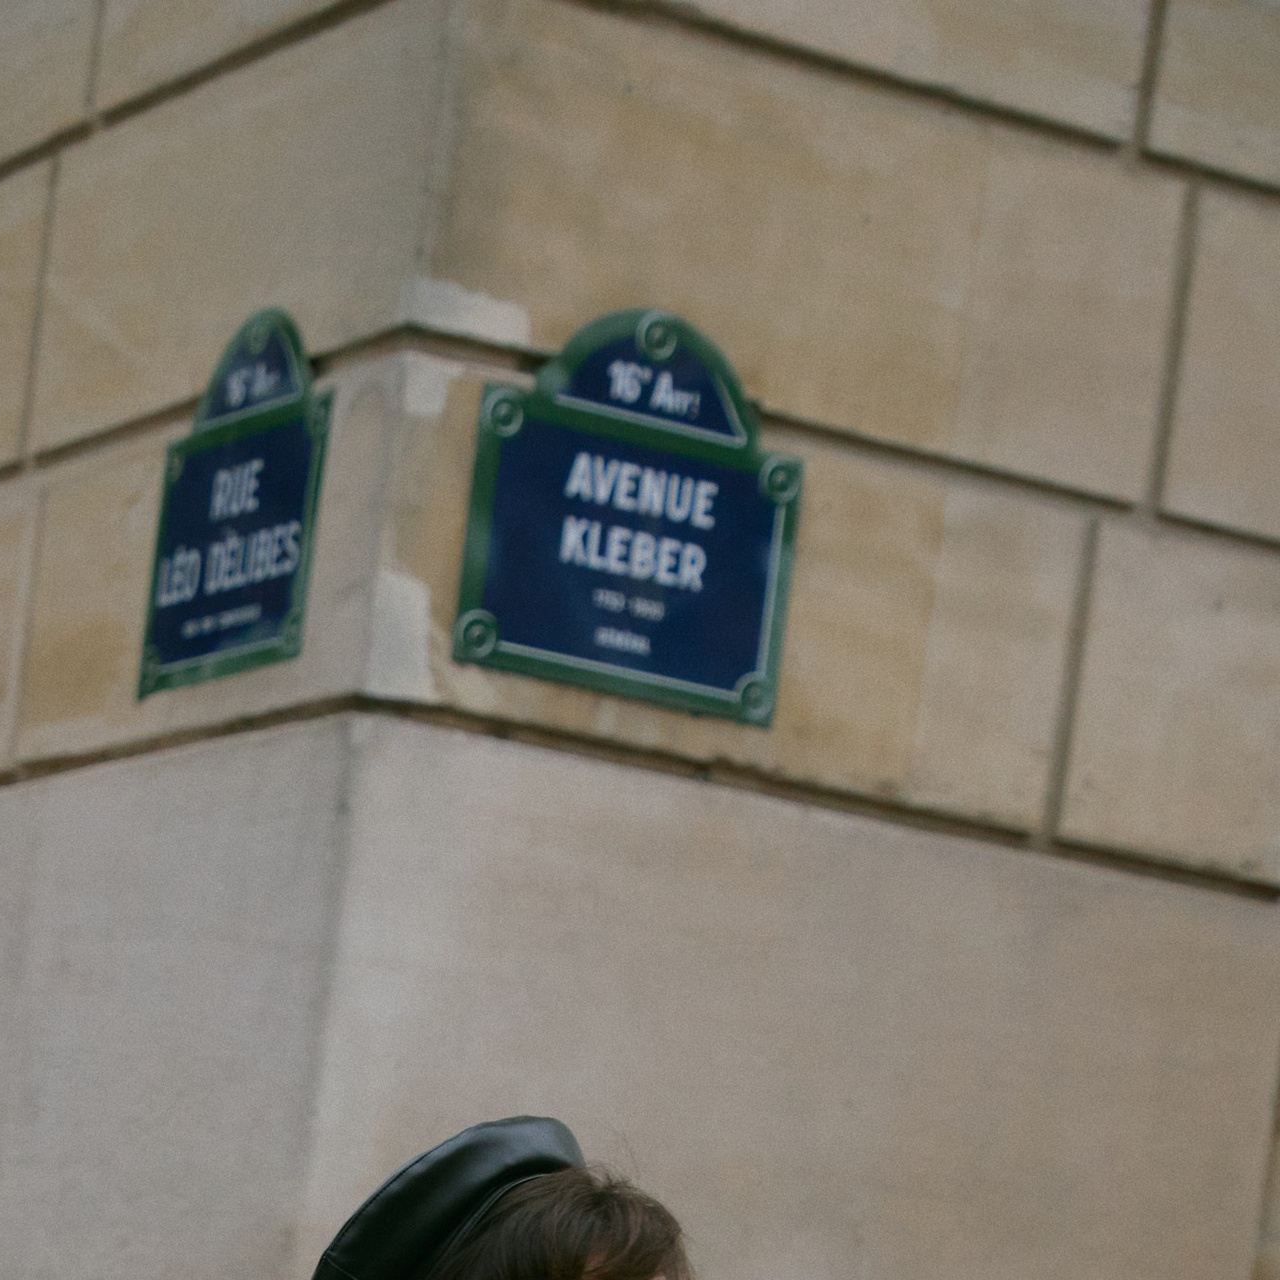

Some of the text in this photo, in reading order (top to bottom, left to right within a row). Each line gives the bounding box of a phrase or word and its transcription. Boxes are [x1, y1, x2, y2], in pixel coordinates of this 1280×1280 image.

[210, 459, 264, 520] RUE
[565, 452, 719, 531] AVENUE
[560, 516, 707, 593] KLEBER
